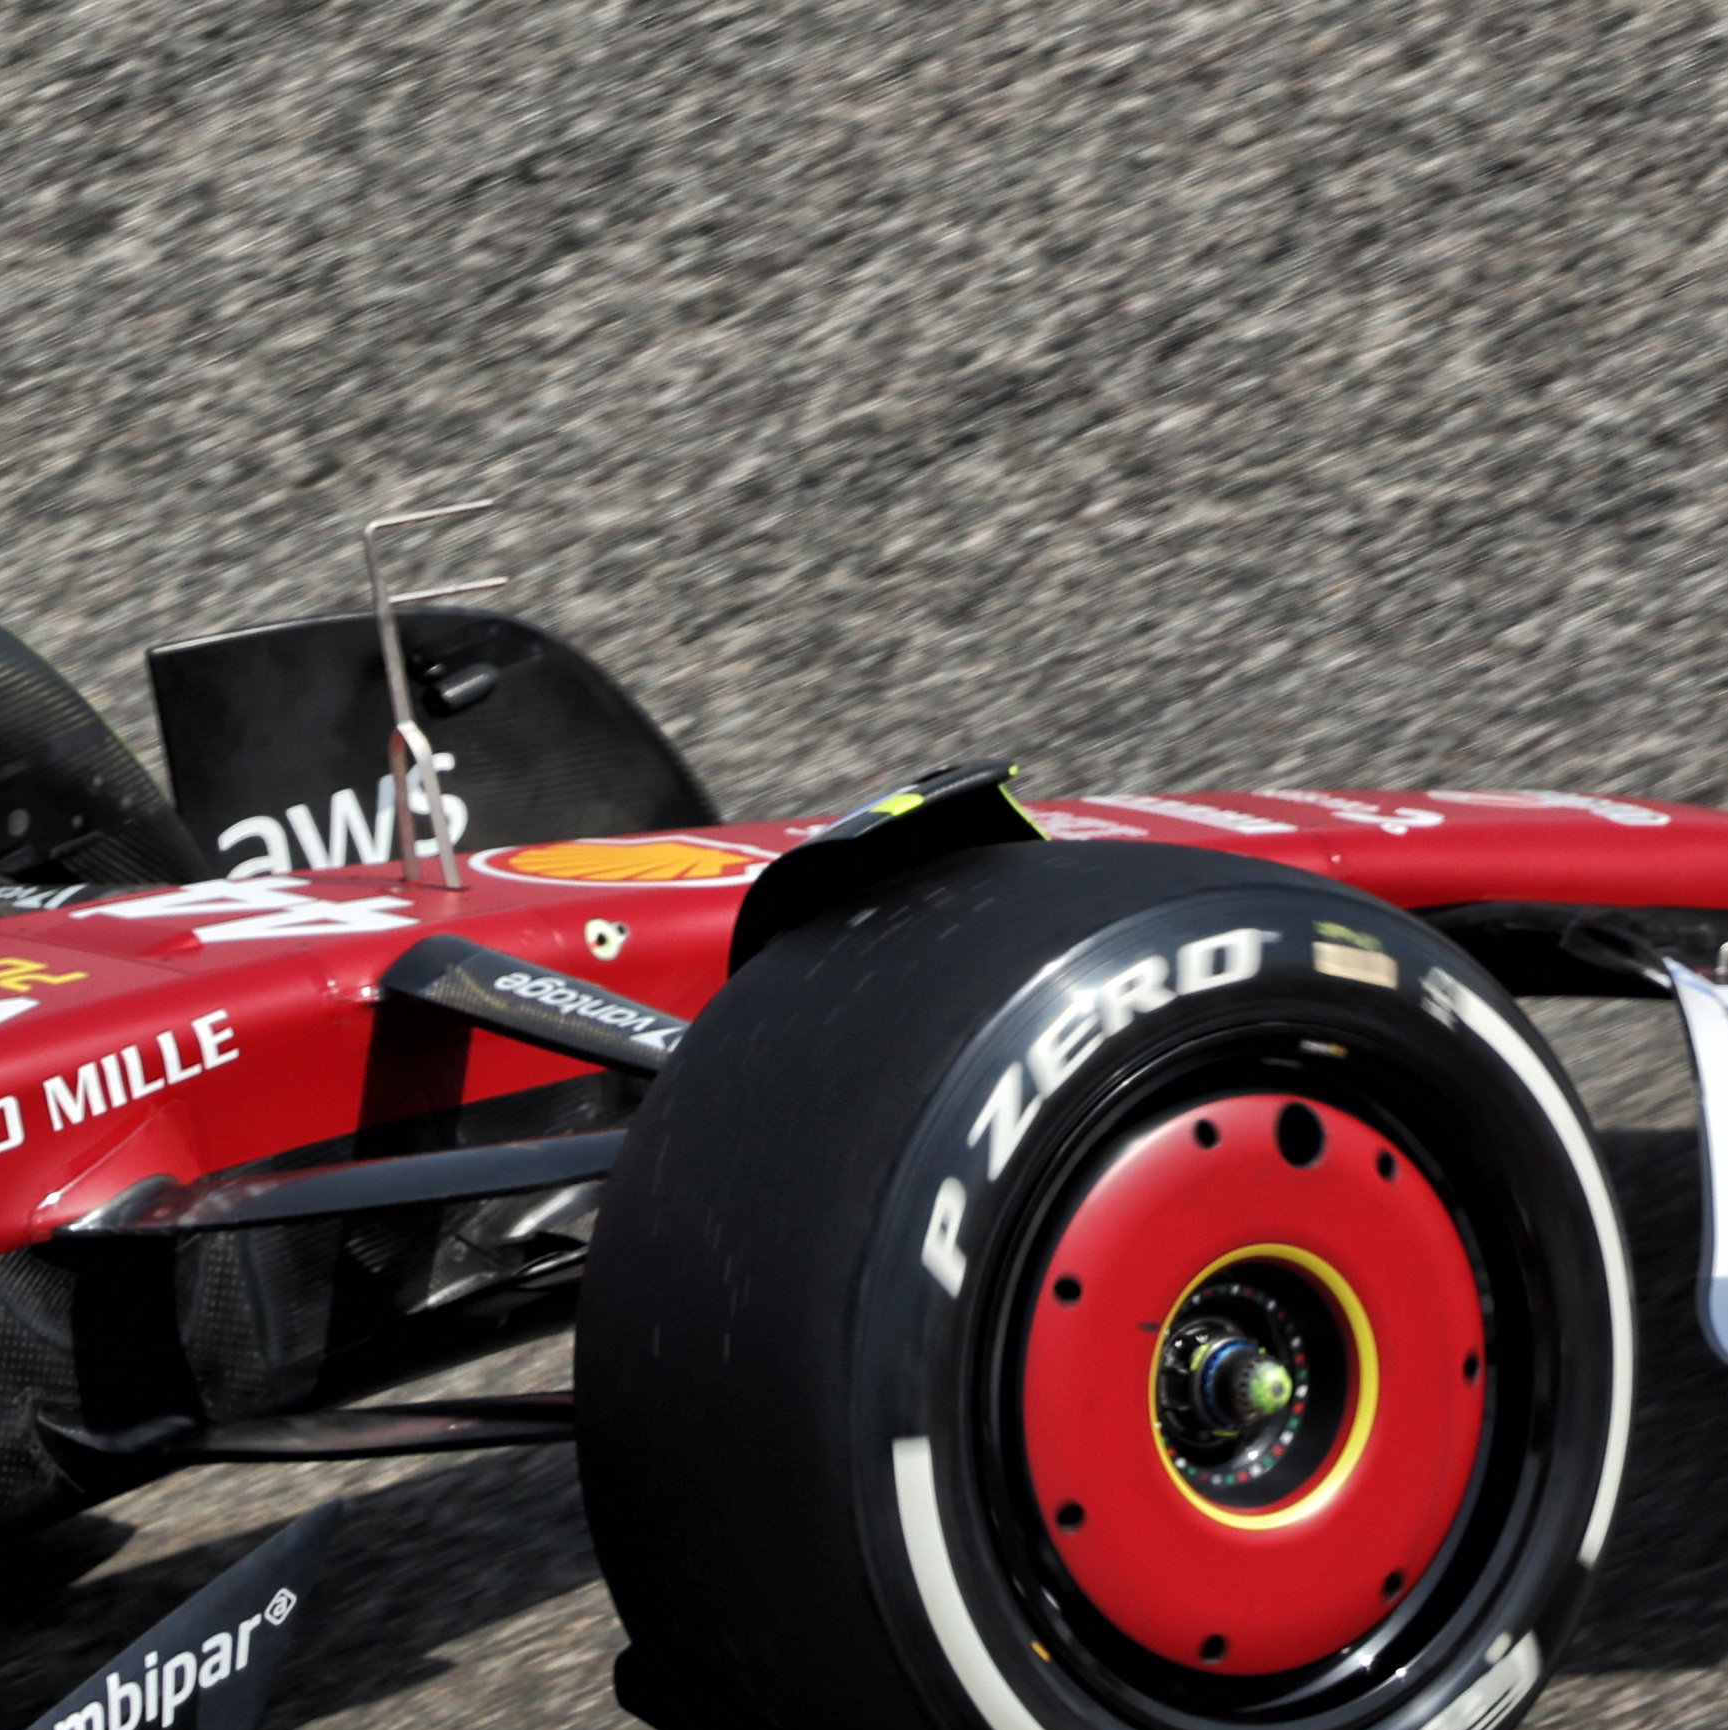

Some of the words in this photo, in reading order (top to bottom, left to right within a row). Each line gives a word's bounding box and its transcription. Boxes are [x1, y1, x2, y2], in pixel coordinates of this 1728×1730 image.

[217, 751, 469, 881] aws
[493, 971, 657, 1033] vantage
[42, 1009, 241, 1133] MILLE
[920, 1176, 968, 1299] P
[966, 925, 1266, 1183] ZERO
